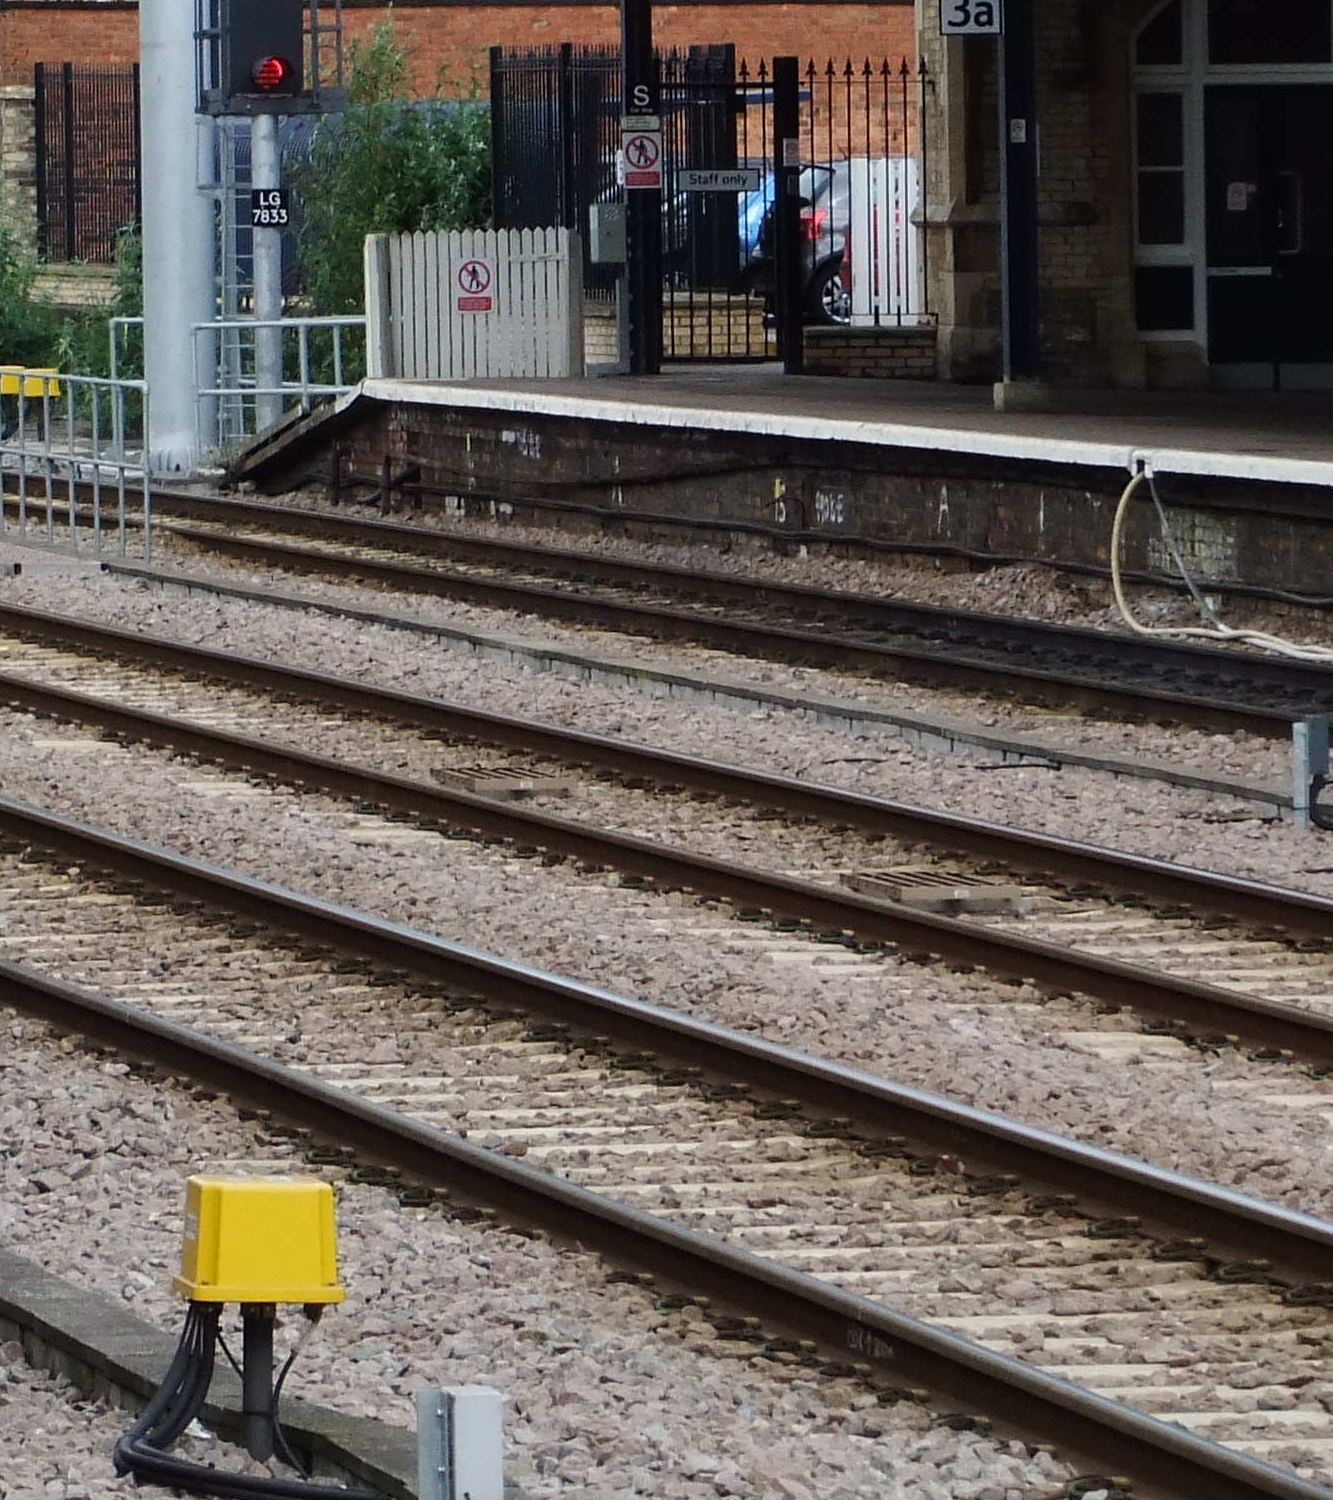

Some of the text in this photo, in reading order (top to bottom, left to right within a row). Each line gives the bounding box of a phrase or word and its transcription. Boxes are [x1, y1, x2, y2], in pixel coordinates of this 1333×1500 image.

[633, 85, 650, 106] S
[688, 173, 749, 187] Staff only
[259, 191, 281, 206] LG
[252, 208, 288, 224] 7833
